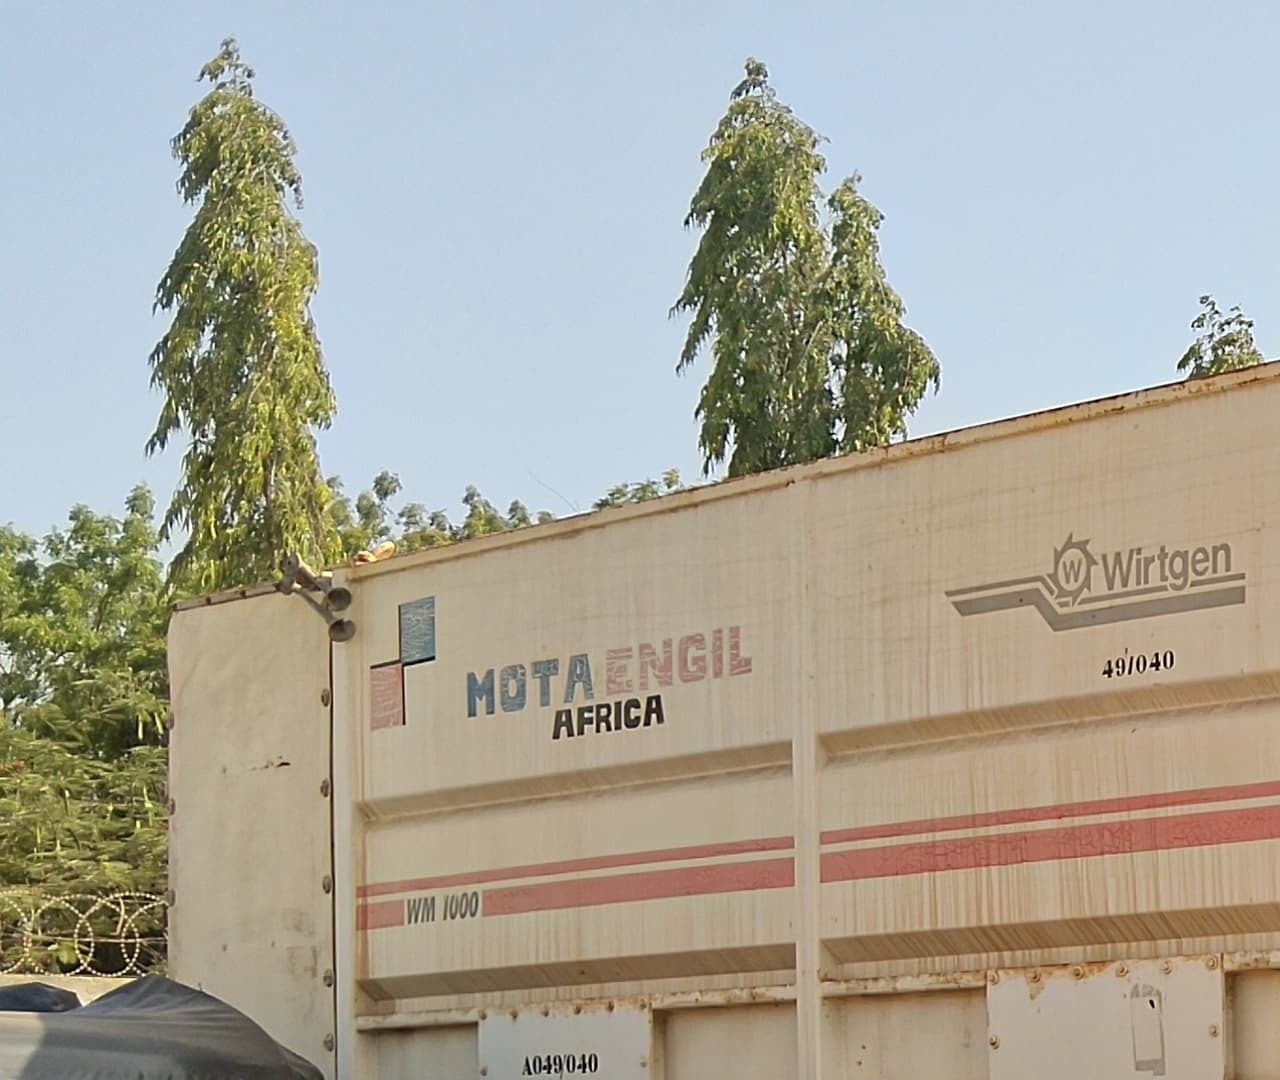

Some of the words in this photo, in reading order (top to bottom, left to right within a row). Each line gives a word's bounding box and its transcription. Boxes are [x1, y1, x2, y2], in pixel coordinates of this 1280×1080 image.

[1063, 558, 1083, 584] W
[1102, 543, 1231, 591] Wirtgen
[467, 653, 594, 718] MOTA
[606, 626, 752, 696] ENGIL
[1102, 650, 1175, 678] 49/040
[552, 695, 664, 740] AFRICA
[407, 897, 436, 925] WM
[442, 891, 479, 920] 1000
[522, 1053, 598, 1079] A049/040
